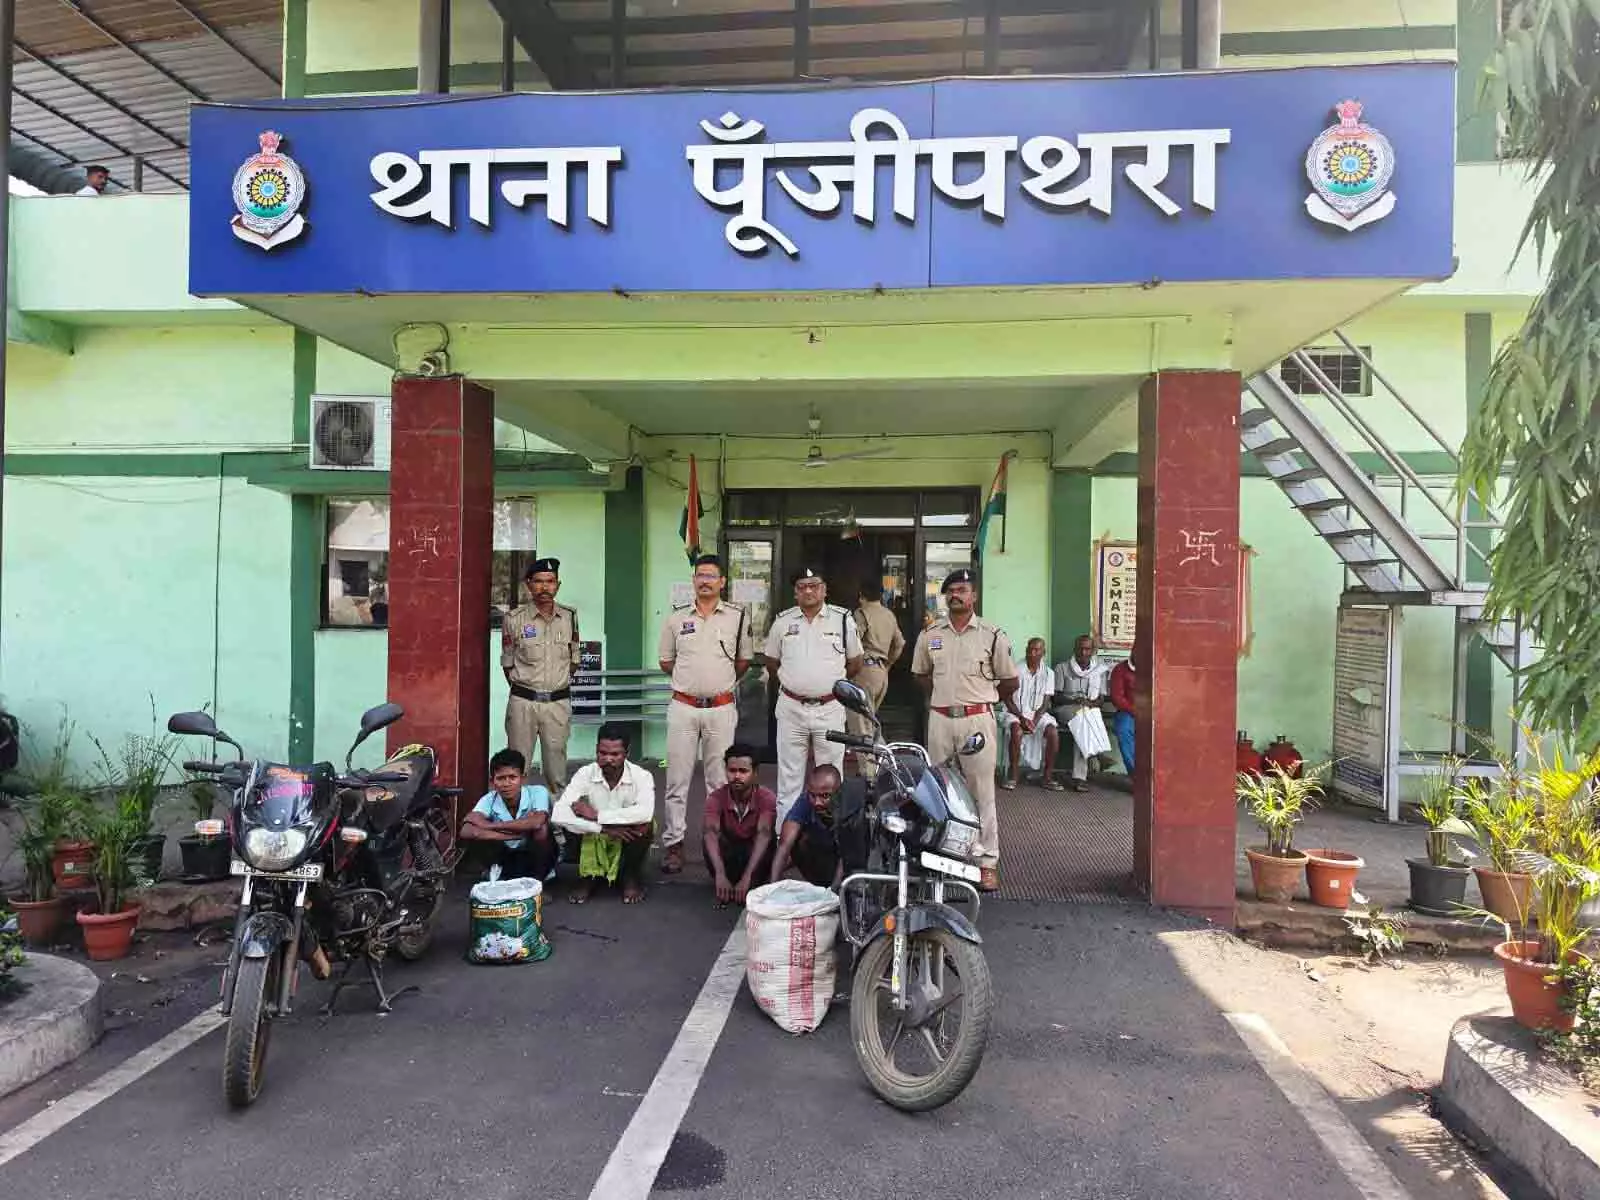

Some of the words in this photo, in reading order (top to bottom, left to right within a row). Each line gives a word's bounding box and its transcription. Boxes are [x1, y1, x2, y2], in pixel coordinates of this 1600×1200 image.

[369, 146, 621, 228] थाना
[686, 107, 1231, 255] पूँजीपथरा
[1109, 577, 1122, 636] SMART
